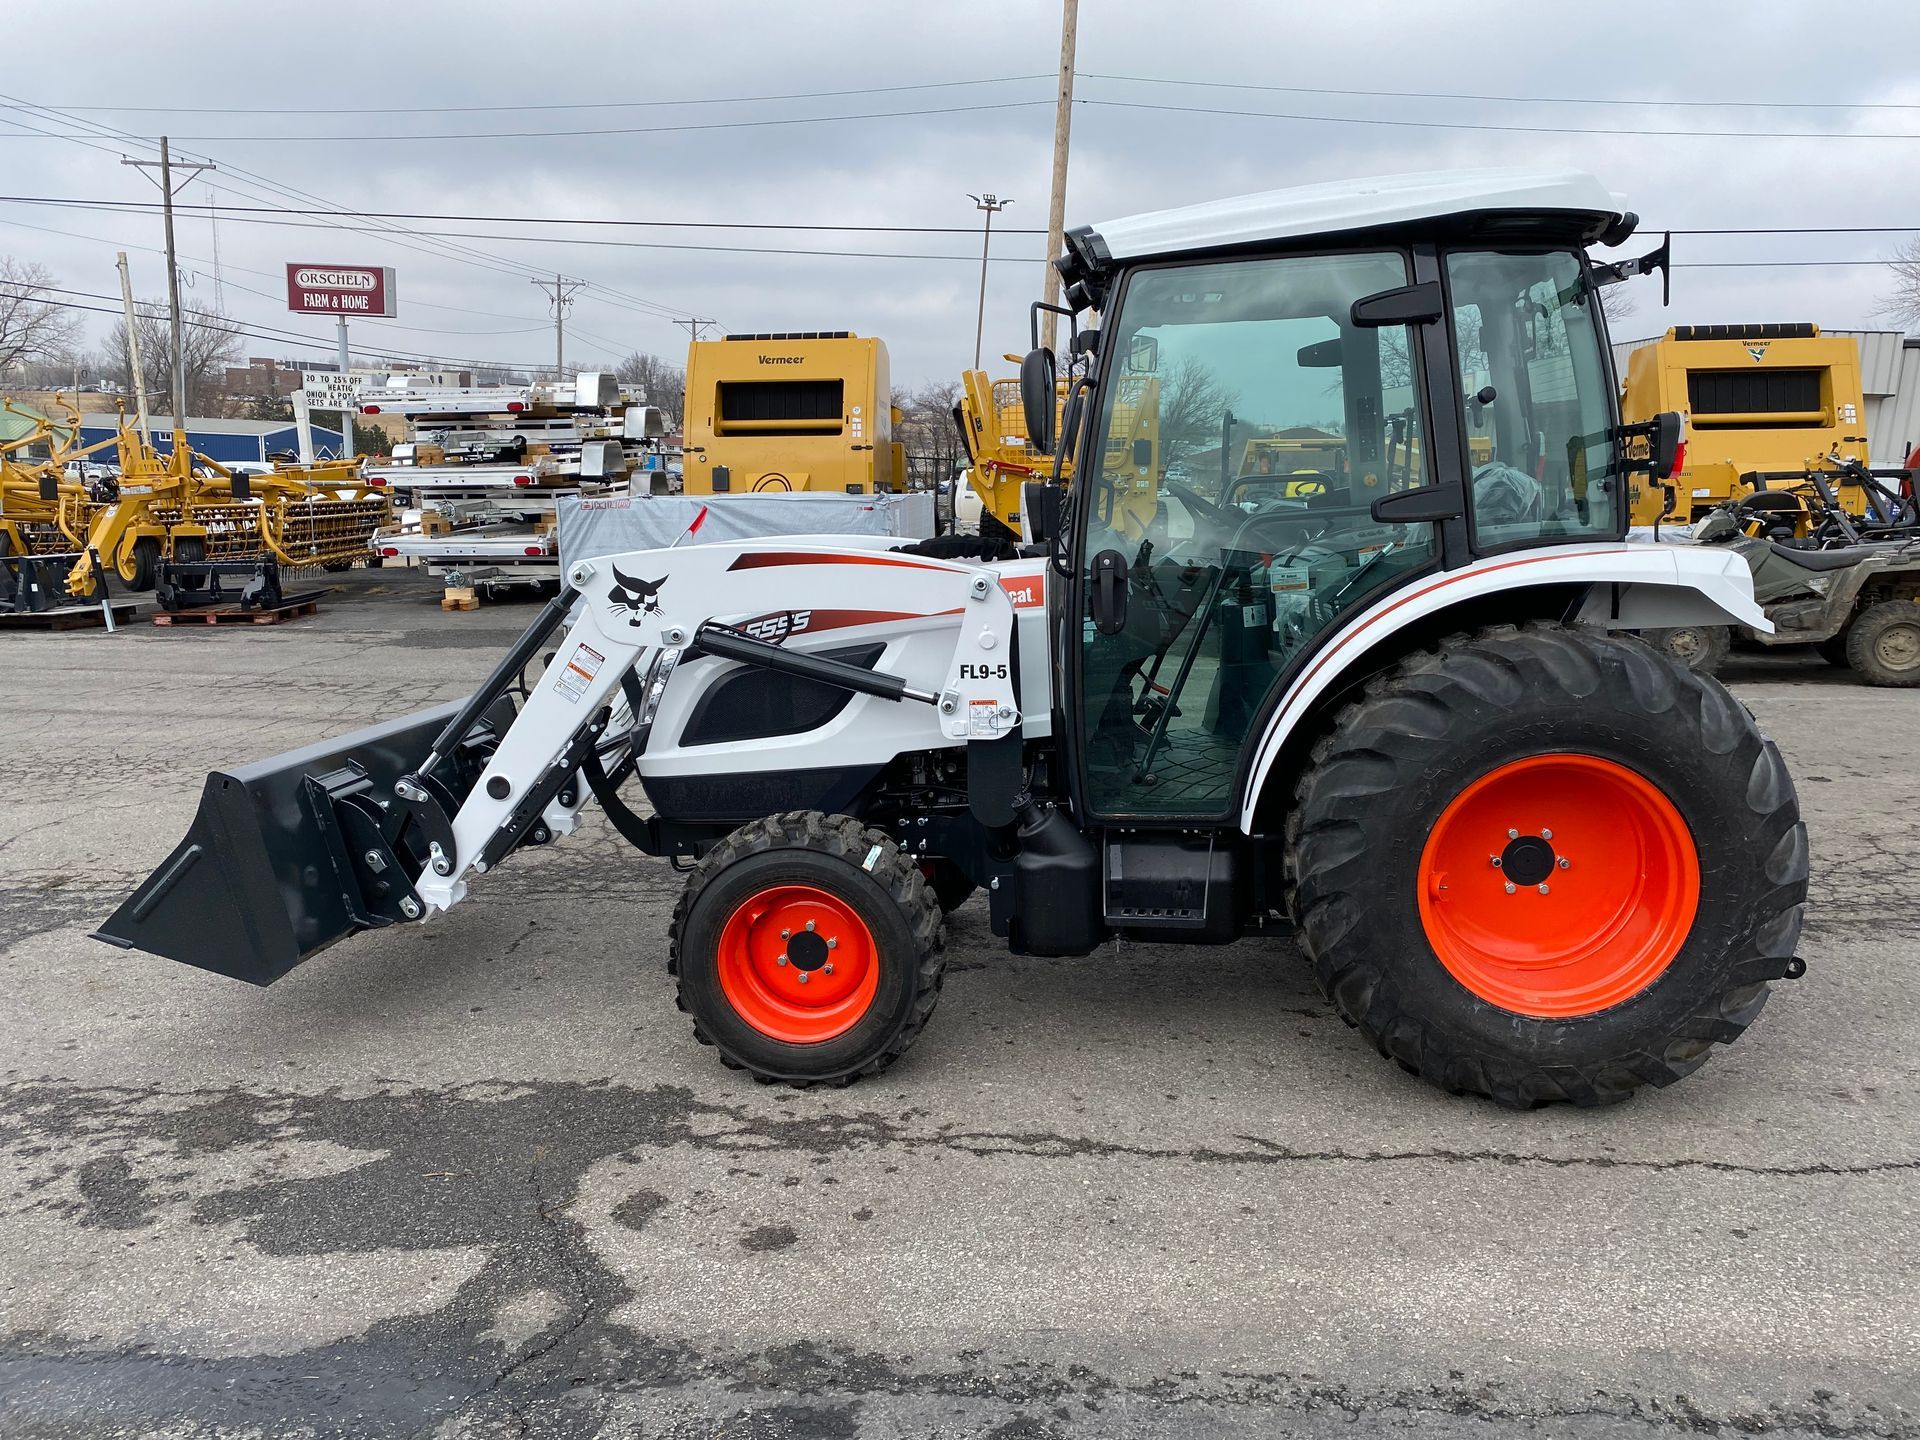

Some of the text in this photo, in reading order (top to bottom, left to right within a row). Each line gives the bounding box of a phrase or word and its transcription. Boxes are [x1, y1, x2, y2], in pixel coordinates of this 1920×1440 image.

[300, 273, 370, 289] ORSCHELN
[303, 293, 369, 310] FARM & HOME
[758, 355, 804, 365] Vermeer
[306, 374, 315, 382] 20
[320, 375, 330, 383] TO
[333, 376, 348, 384] 25%
[306, 390, 327, 399] ONION
[327, 384, 353, 392] HEATIG
[307, 398, 324, 406] SETS
[328, 400, 342, 408] ARE
[1629, 442, 1649, 459] Verme
[1008, 587, 1032, 603] cat
[960, 664, 1007, 680] FL9-5
